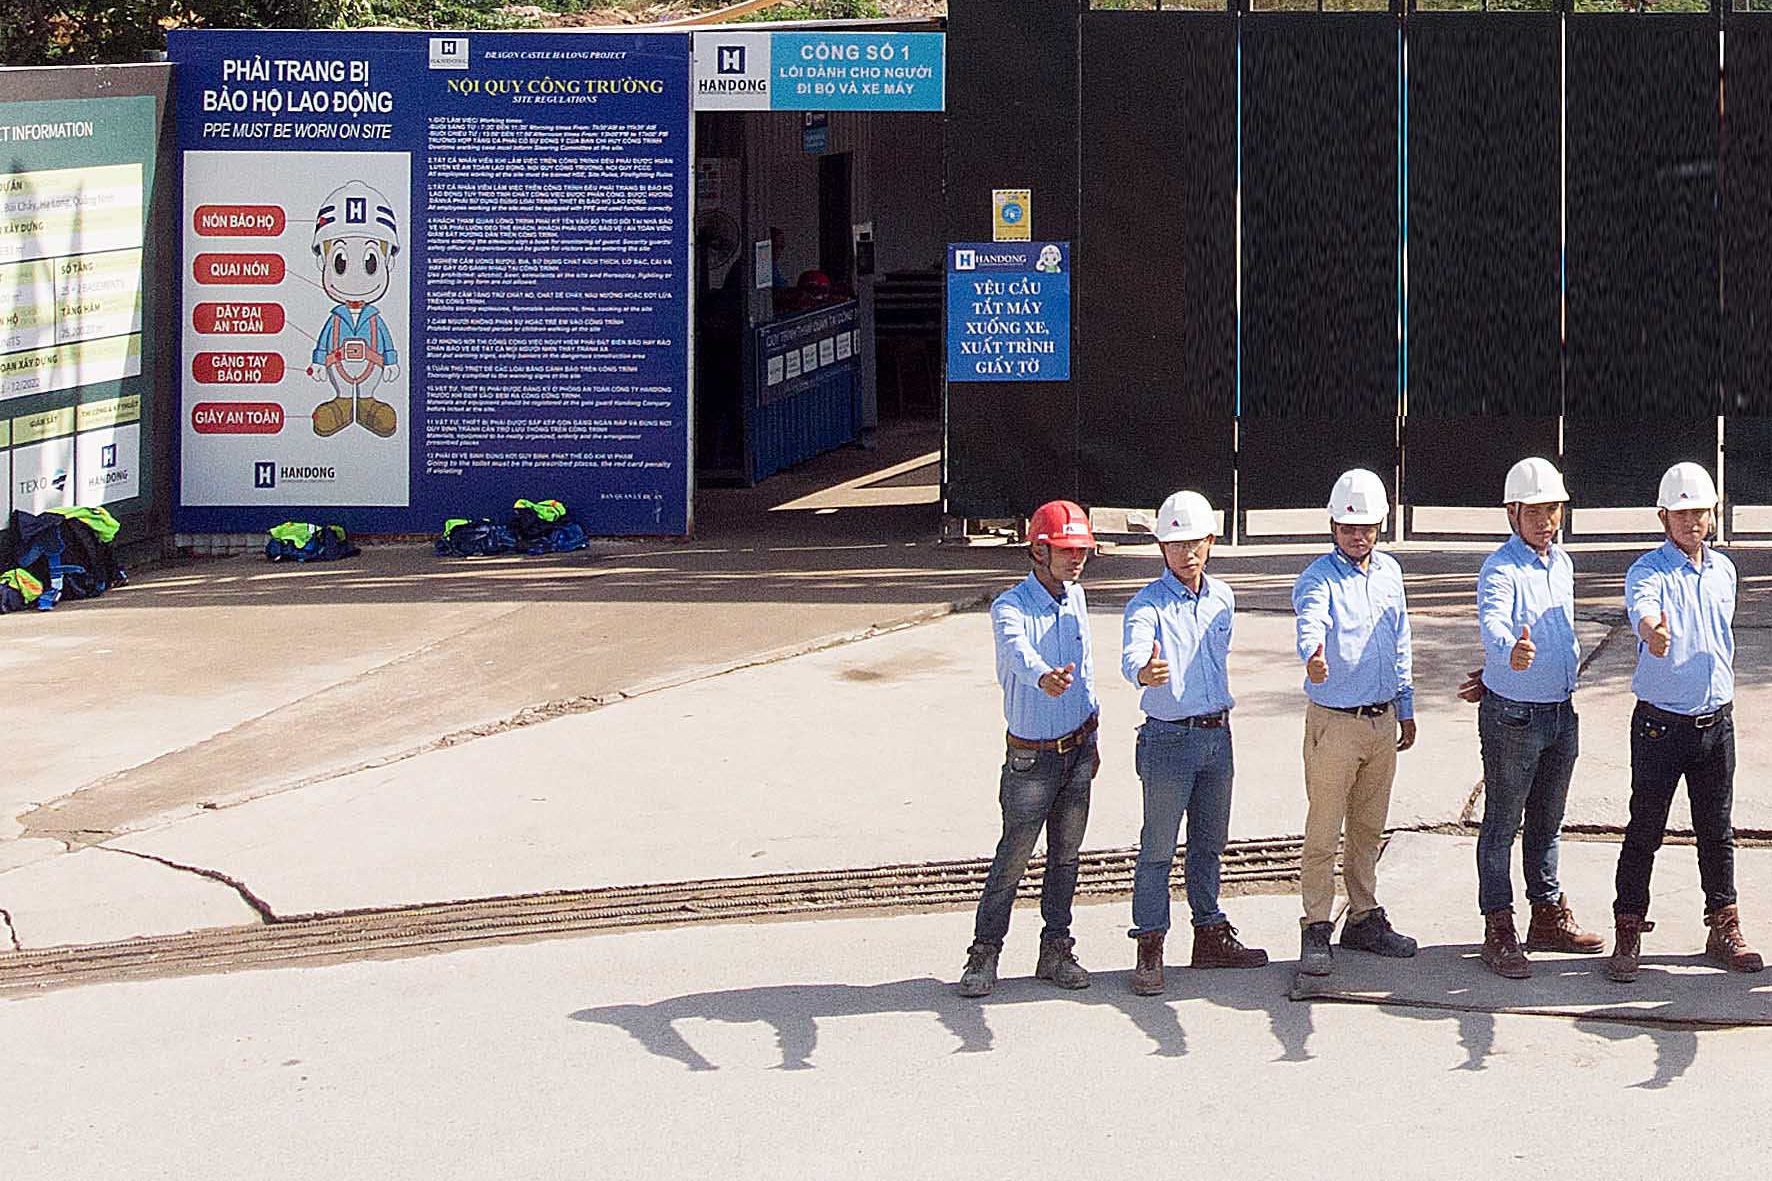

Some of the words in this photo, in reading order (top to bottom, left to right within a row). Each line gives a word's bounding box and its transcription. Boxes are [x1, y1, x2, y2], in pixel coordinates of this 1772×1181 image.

[590, 51, 627, 59] PROJECT
[901, 46, 910, 60] 1
[223, 55, 270, 81] PHẢI
[274, 60, 344, 82] TRANG
[350, 60, 369, 87] BỊ
[850, 66, 881, 78] CHO
[448, 77, 480, 96] NỘI
[485, 79, 523, 96] QUY
[528, 76, 581, 94] CÔNG
[584, 76, 664, 94] TRƯỜNG
[699, 79, 766, 92] HANDONG
[797, 83, 812, 94] ĐI
[839, 81, 858, 94] VÀ
[862, 83, 881, 94] XE
[884, 81, 915, 94] MÁY
[203, 85, 248, 111] BẢO
[253, 88, 283, 116] HỘ
[287, 91, 329, 112] LAO
[333, 89, 393, 117] ĐỘNG
[512, 95, 530, 104] SITE
[533, 95, 598, 104] REGULATIONS
[12, 121, 93, 140] INFORMATION
[203, 122, 231, 137] PPE
[232, 123, 272, 138] MUST
[273, 123, 293, 138] BE
[295, 123, 337, 138] WORN
[339, 123, 361, 139] ON
[362, 124, 393, 139] SITE
[202, 212, 230, 227] NÓN
[256, 214, 275, 230] HỘ
[975, 254, 1027, 264] HANDONG
[211, 263, 240, 276] QUAI
[243, 260, 269, 276] NÓN
[974, 278, 1004, 295] YÊU
[1008, 277, 1041, 295] CẦU
[216, 305, 240, 318] DÂY
[1006, 301, 1042, 315] MÁY
[213, 320, 230, 332] AN
[232, 318, 263, 332] TOÀN
[965, 317, 1020, 335] XUỐNG
[961, 337, 1003, 354] XUẤT
[1005, 338, 1055, 354] TRÌNH
[248, 356, 267, 367] TAY
[976, 355, 1015, 374] GIẤY
[246, 370, 261, 385] HỘ
[229, 411, 245, 423] AN
[246, 409, 280, 423] TOÀN
[280, 467, 335, 479] HANDONG
[20, 477, 47, 494] TEXO
